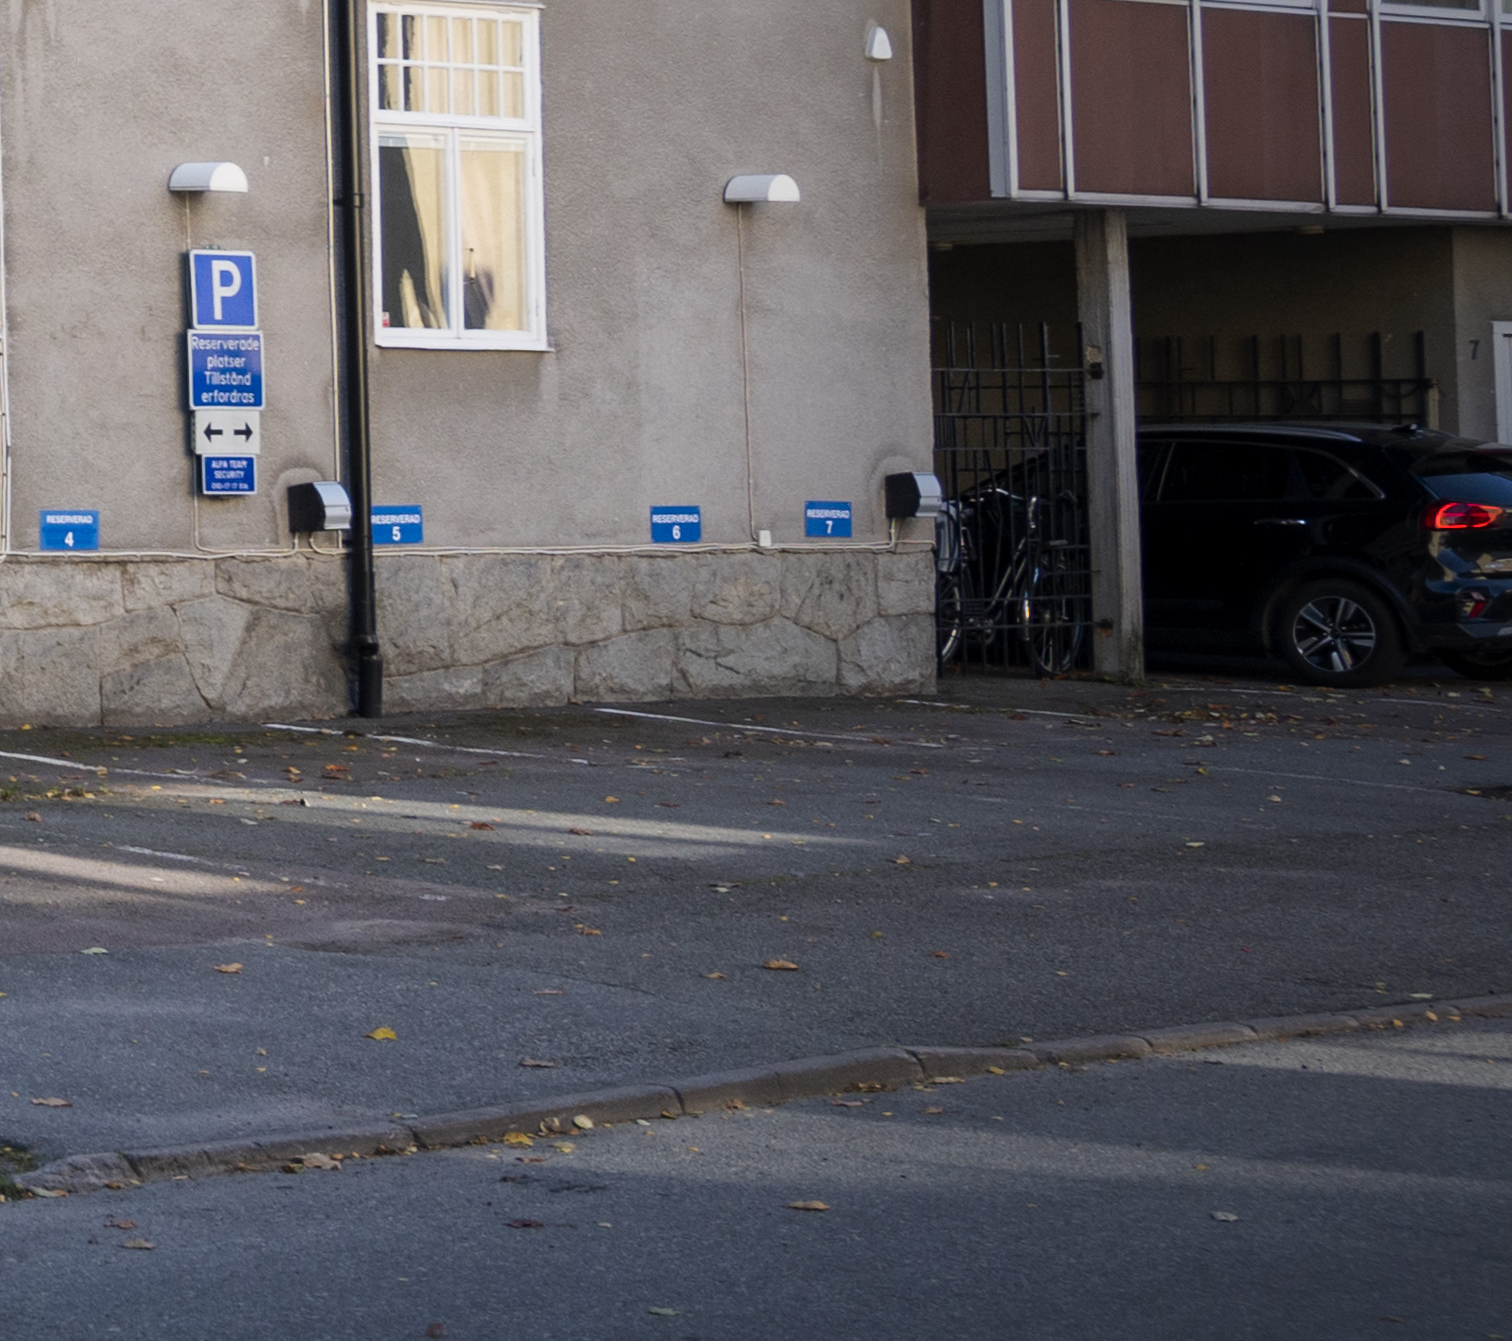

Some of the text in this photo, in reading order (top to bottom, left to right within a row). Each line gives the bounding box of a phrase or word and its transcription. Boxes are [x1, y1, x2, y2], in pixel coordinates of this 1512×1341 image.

[211, 259, 242, 321] P
[191, 335, 260, 351] Reserverade
[1468, 339, 1480, 361] 7
[206, 354, 247, 370] platser
[204, 370, 252, 386] Tillstånd
[200, 389, 255, 404] erfordras
[46, 514, 94, 524] RESERVERAD
[652, 513, 699, 524] RESERVERAD
[806, 508, 850, 519] RESERVERAD
[391, 526, 401, 541] 5
[672, 525, 681, 540] 6
[825, 520, 834, 534] 7
[64, 531, 75, 547] 4
